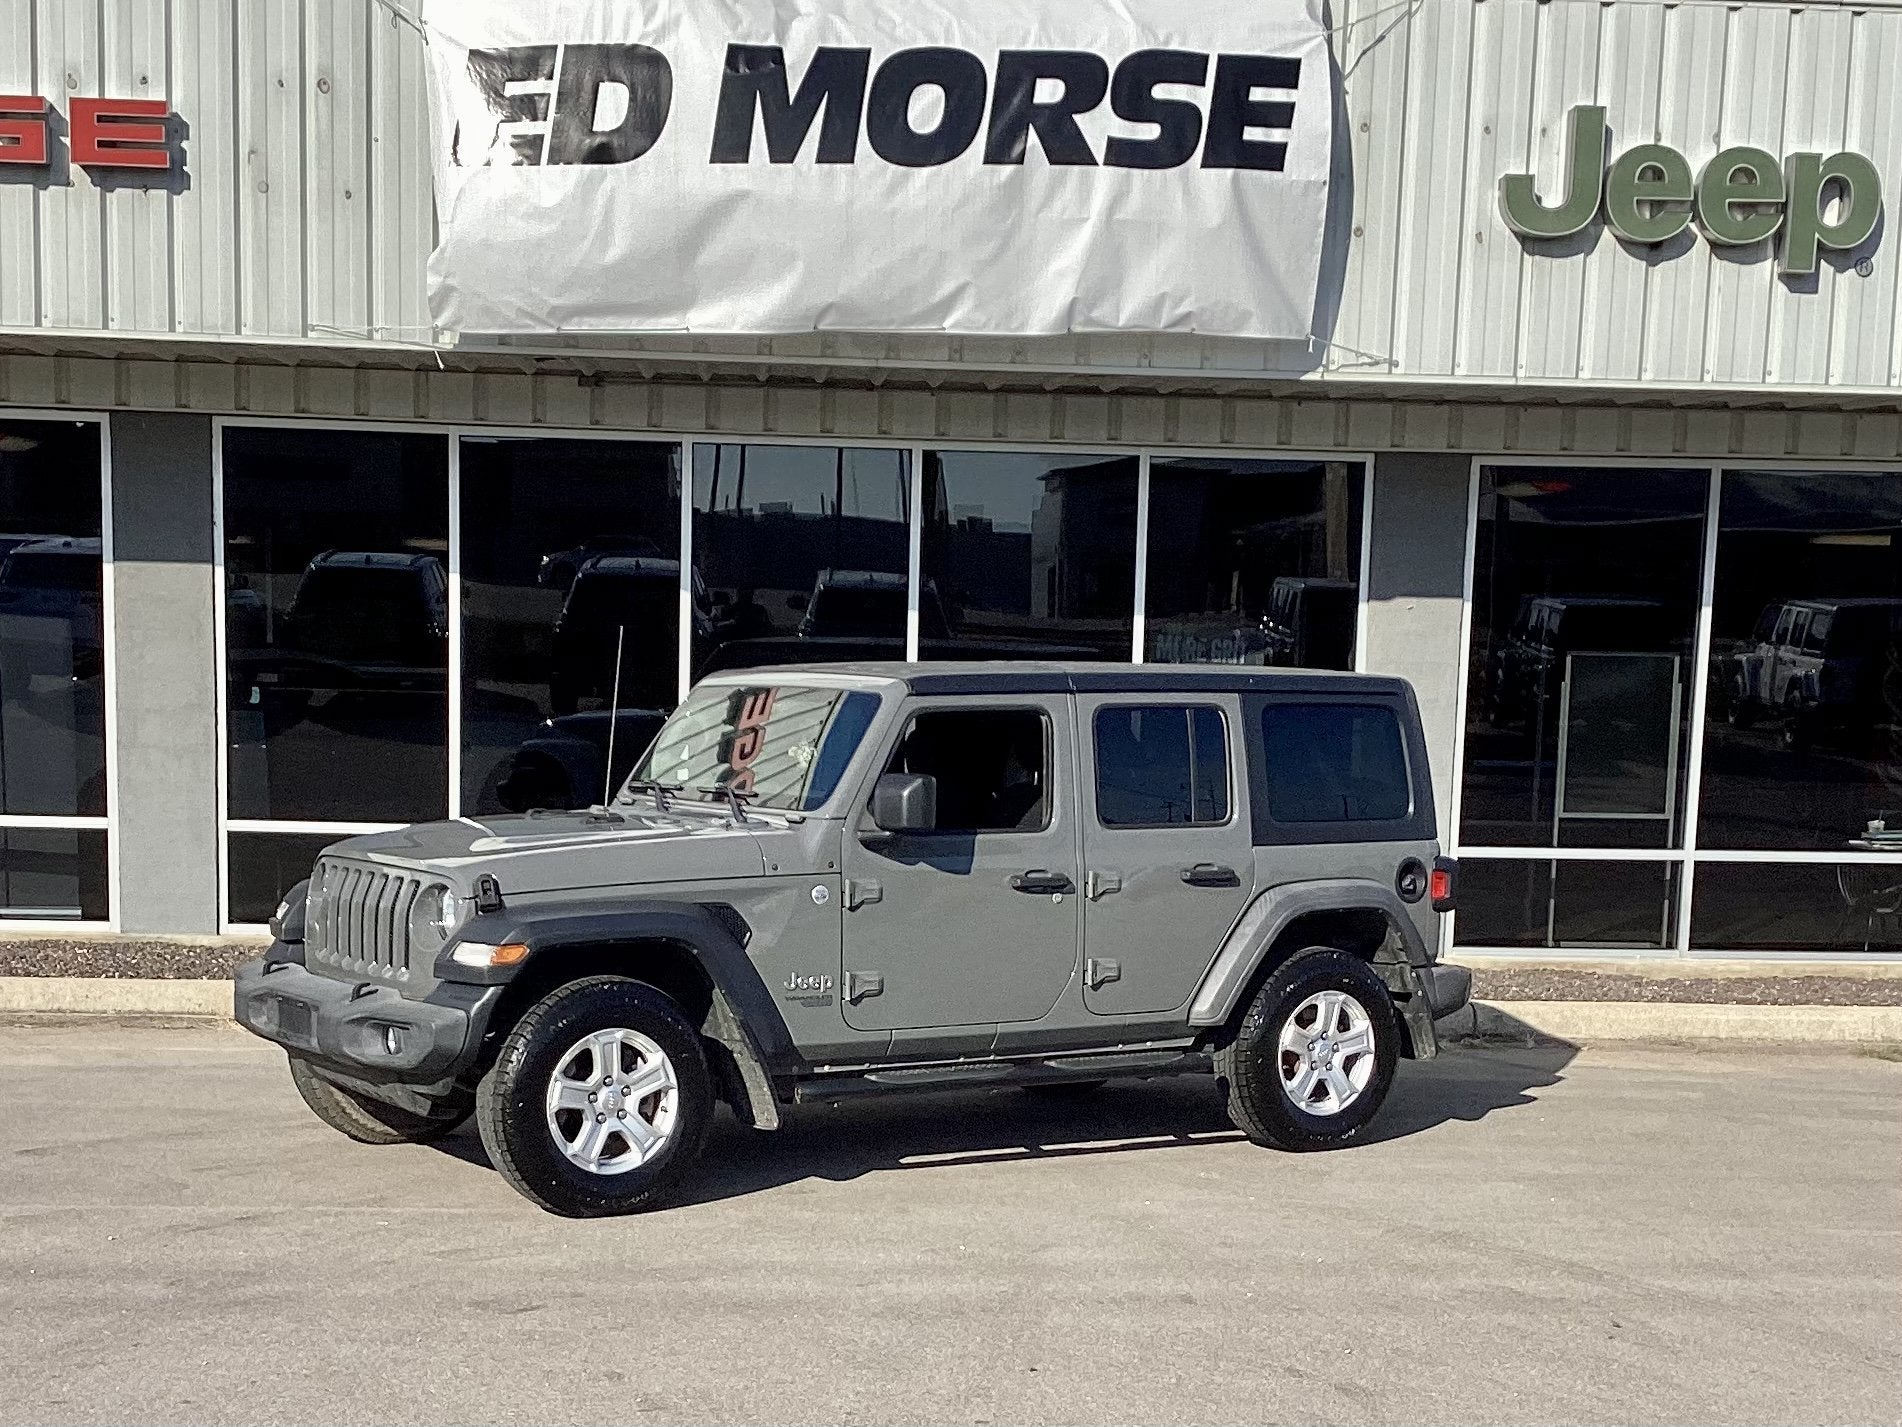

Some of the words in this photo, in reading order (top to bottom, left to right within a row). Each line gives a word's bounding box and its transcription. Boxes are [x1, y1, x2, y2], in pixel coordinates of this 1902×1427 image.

[449, 43, 673, 167] ED
[709, 42, 1302, 172] MORSE
[1499, 105, 1881, 275] Jeep
[783, 971, 834, 993] Jeep
